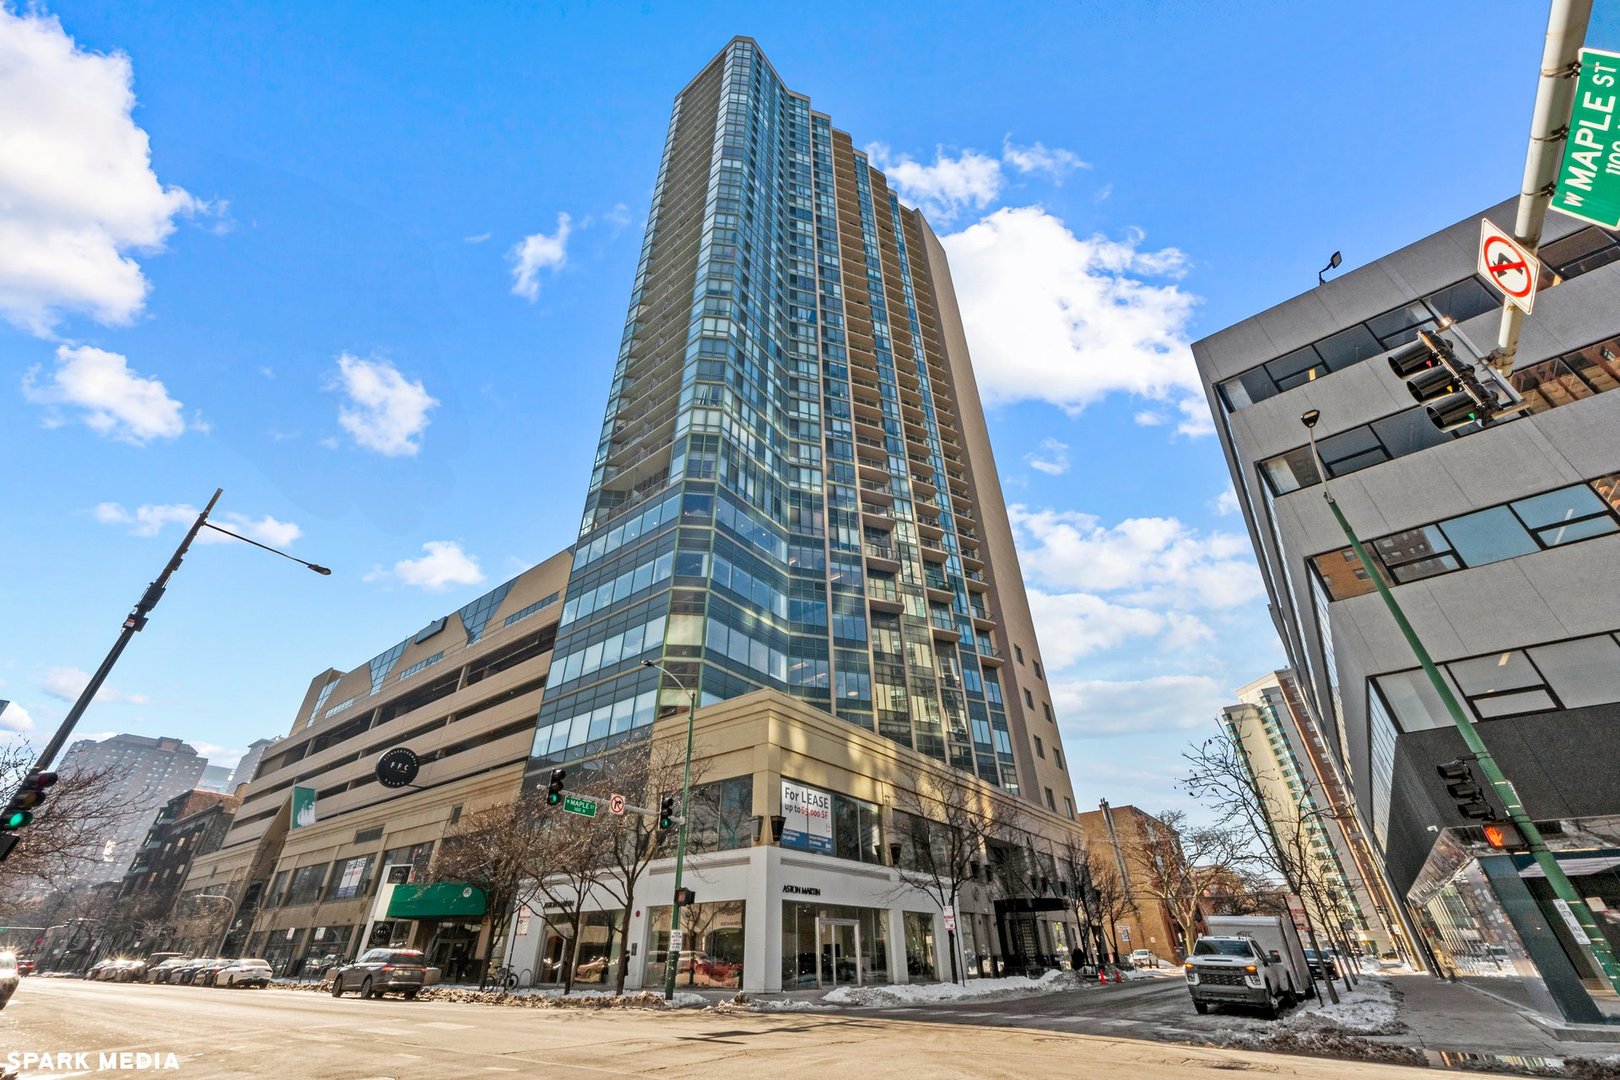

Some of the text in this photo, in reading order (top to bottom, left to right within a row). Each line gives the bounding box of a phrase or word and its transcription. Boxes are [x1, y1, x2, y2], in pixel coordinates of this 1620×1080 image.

[1563, 62, 1616, 207] W MAPLE ST
[784, 786, 829, 809] For LEASE
[570, 799, 589, 809] MAPLE
[784, 803, 793, 814] up
[794, 805, 800, 813] to
[782, 884, 801, 894] ASTON
